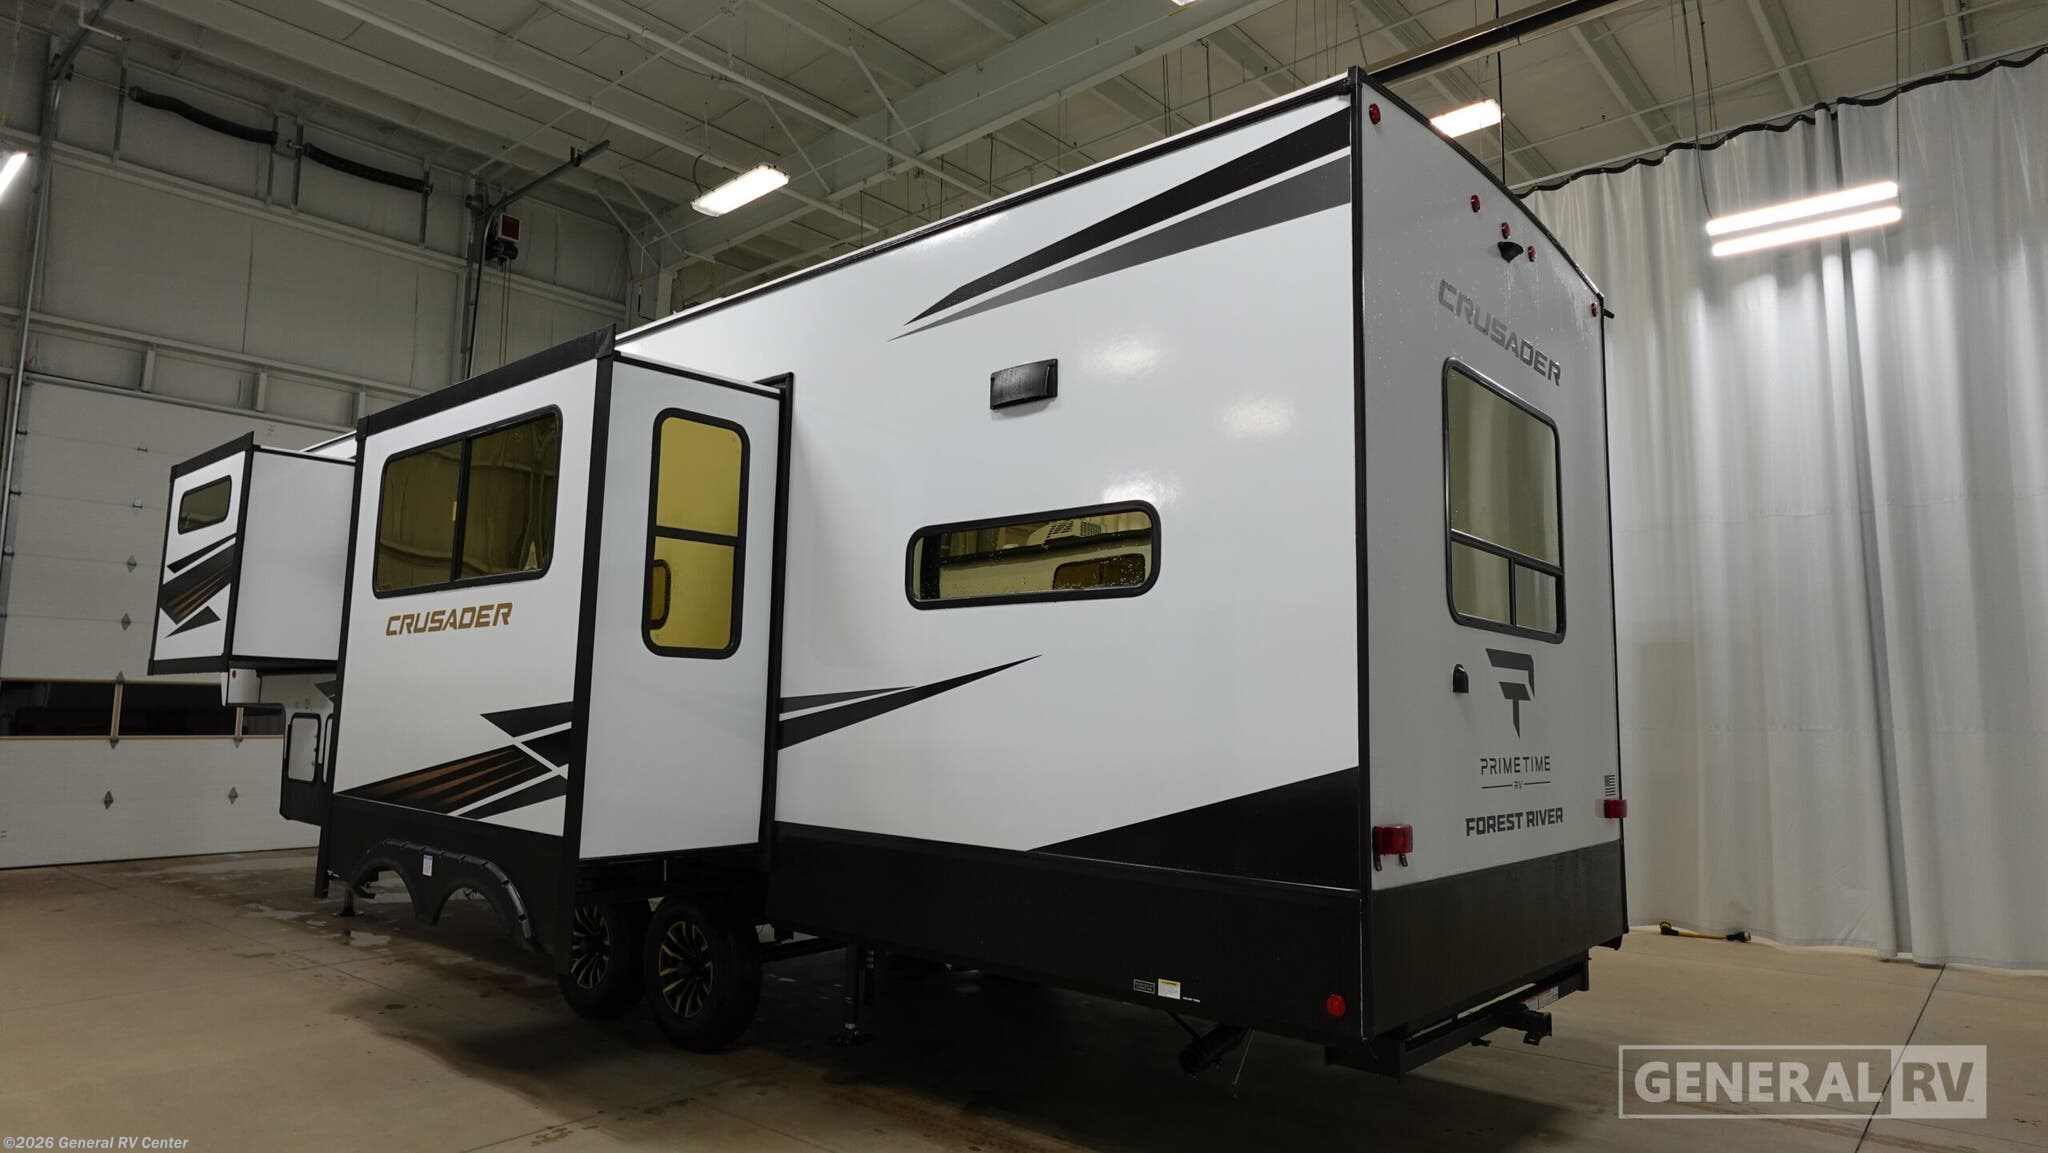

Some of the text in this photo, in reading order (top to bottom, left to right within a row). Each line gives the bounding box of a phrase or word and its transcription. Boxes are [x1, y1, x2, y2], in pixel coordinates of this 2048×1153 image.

[1439, 280, 1560, 386] CRUSADER
[386, 602, 513, 636] CRUSADER
[1514, 780, 1523, 790] RV
[1465, 807, 1563, 837] FOREST RIVER
